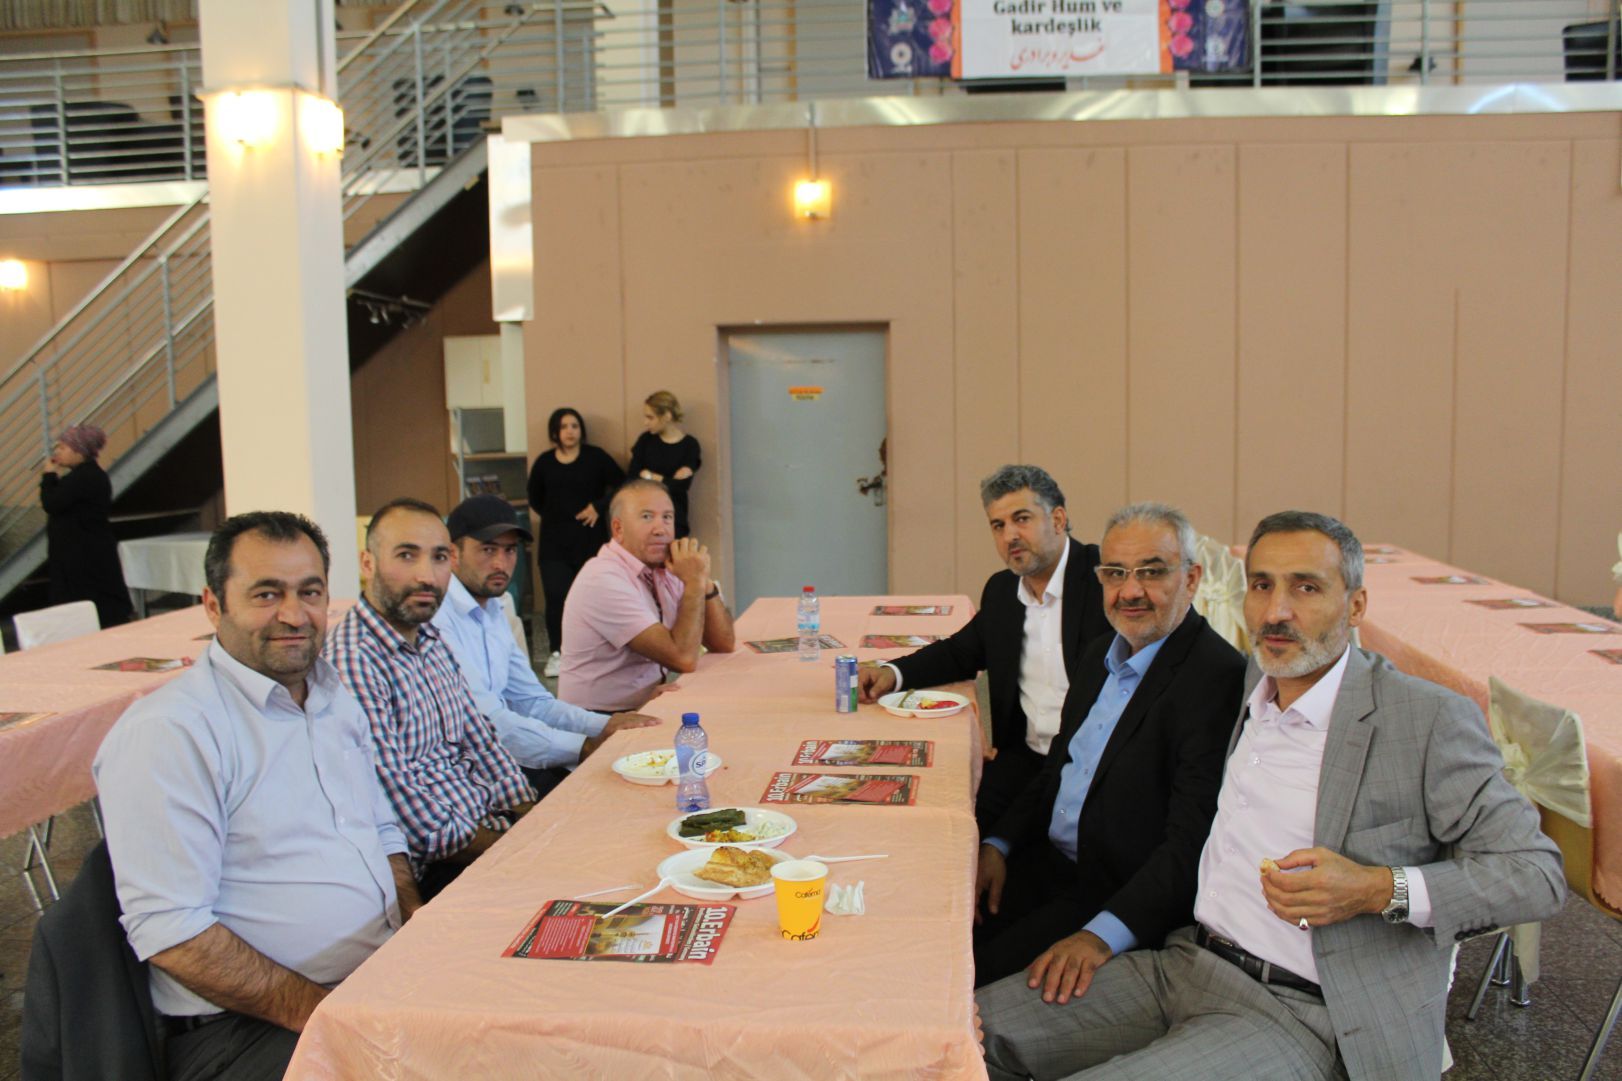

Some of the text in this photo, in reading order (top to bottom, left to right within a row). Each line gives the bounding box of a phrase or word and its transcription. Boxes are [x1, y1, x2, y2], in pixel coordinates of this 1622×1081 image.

[993, 0, 1123, 14] Gadir Hum ve
[1011, 18, 1102, 36] kardeşlik
